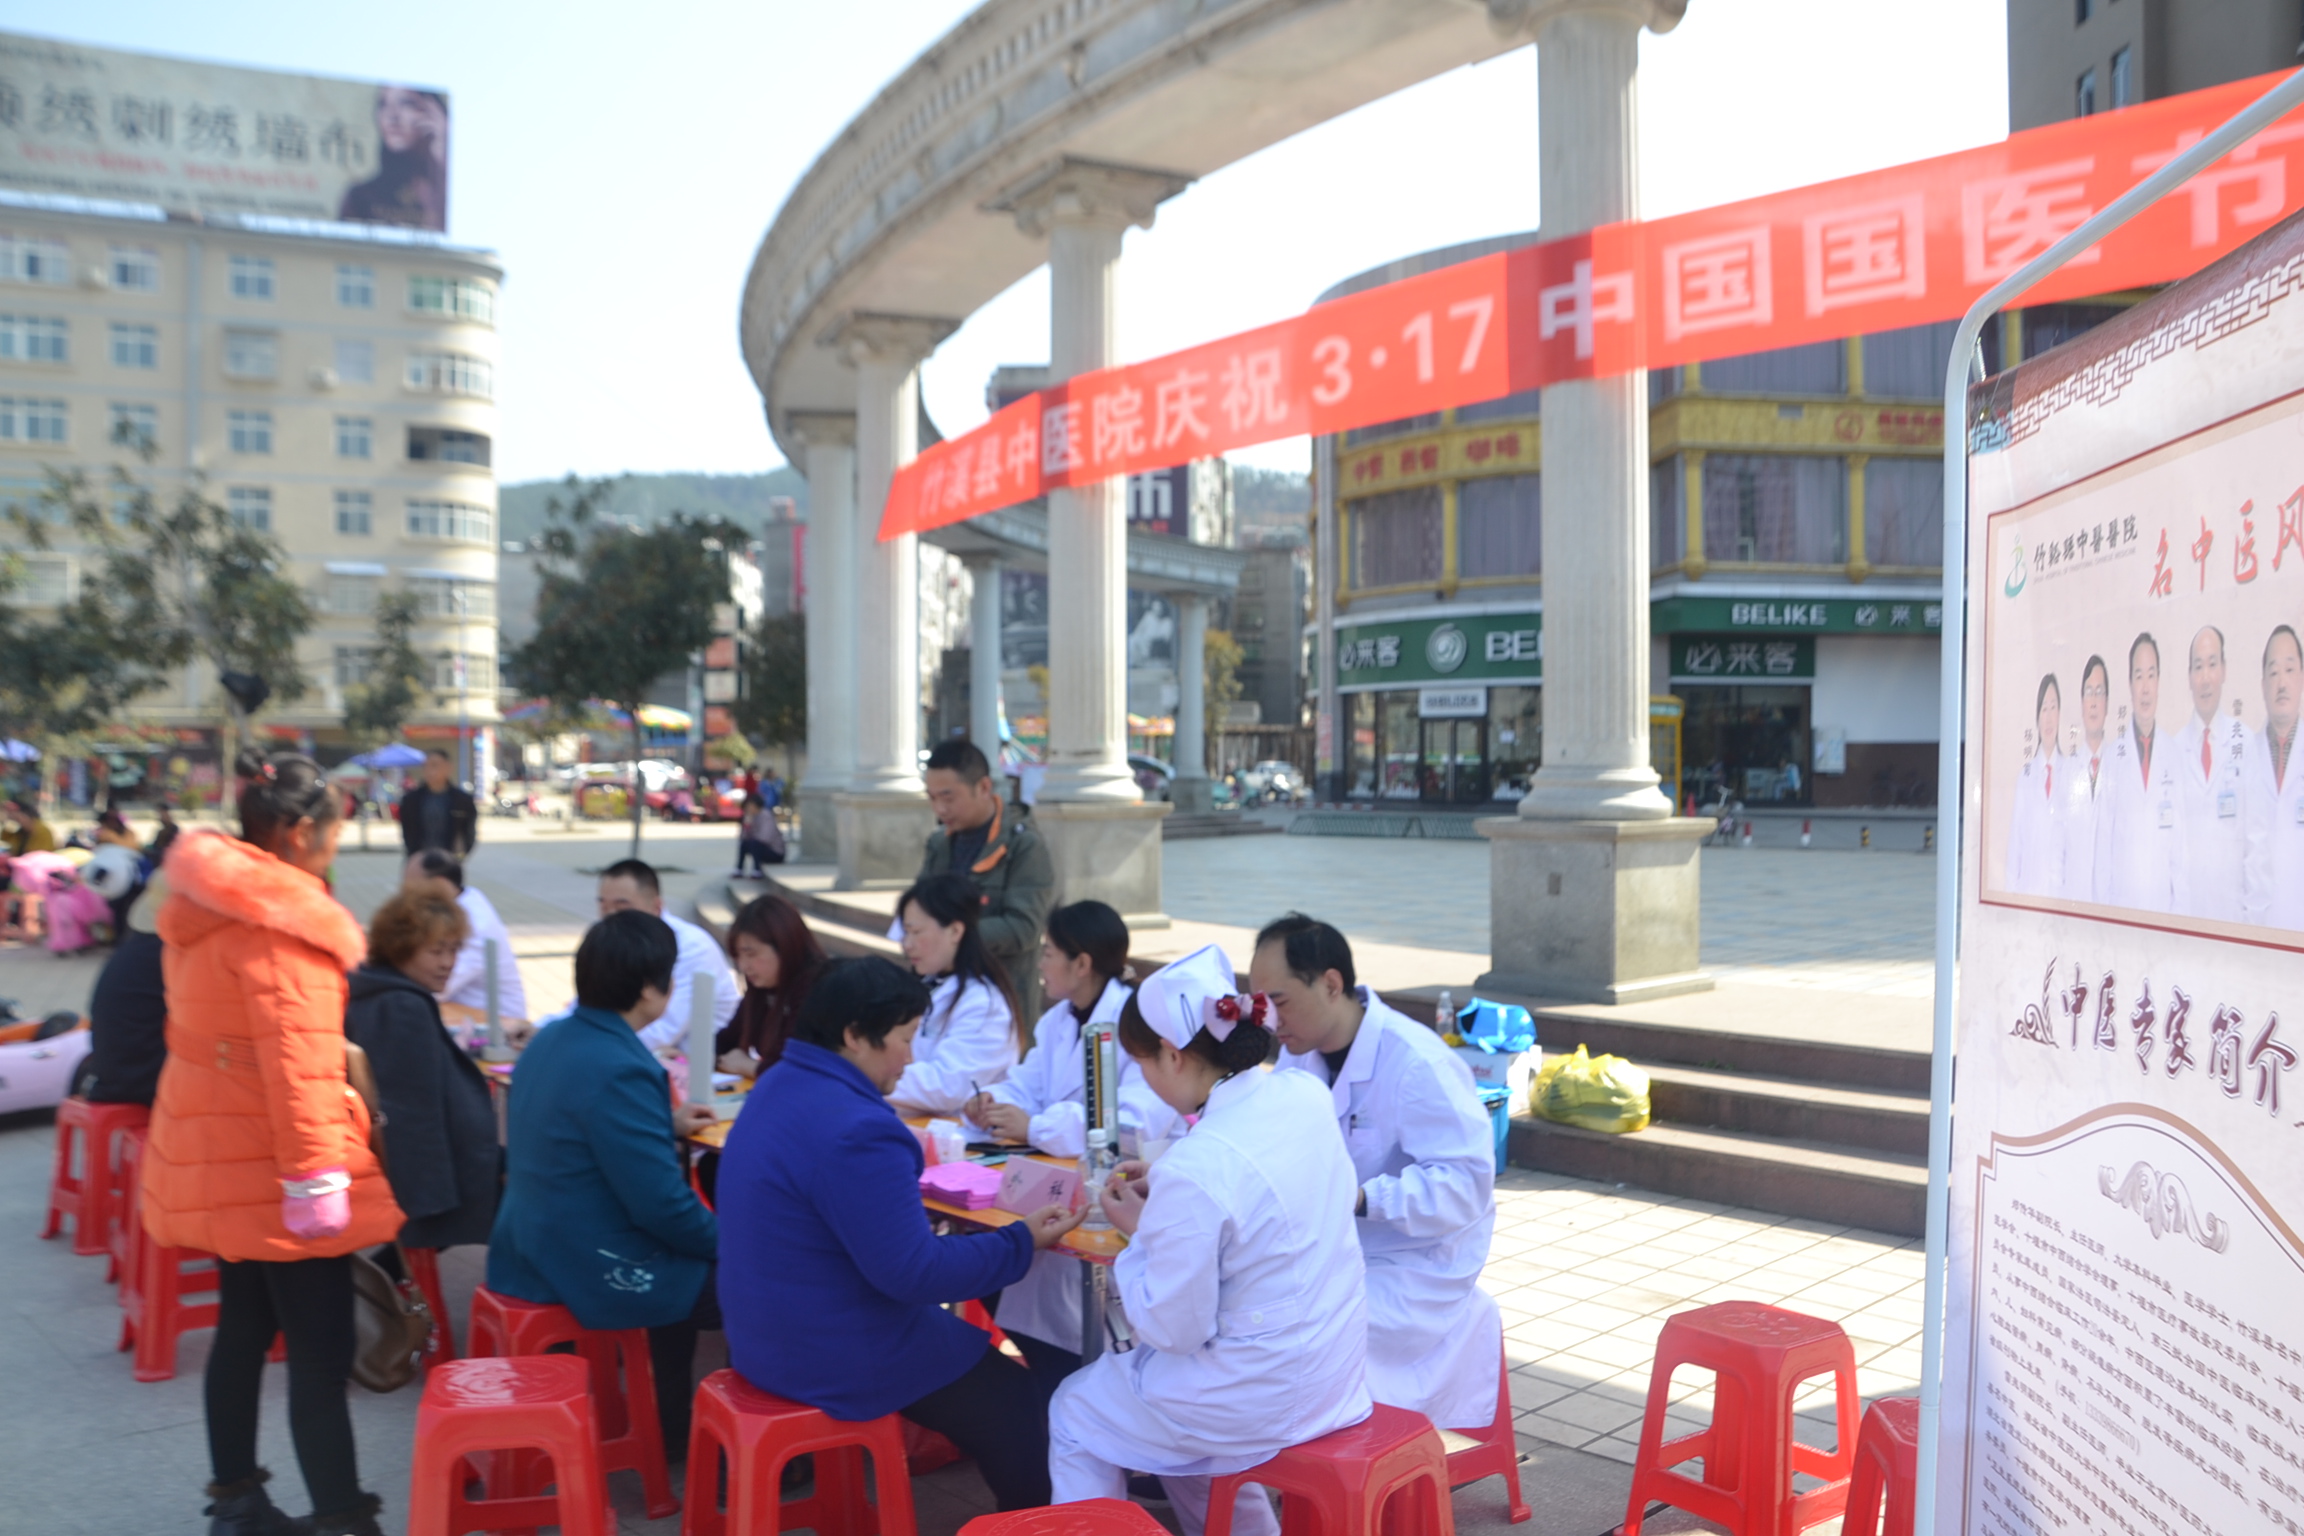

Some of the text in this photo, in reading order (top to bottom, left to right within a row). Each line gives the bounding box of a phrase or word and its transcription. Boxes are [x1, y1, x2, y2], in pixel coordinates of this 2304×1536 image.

[1731, 603, 1828, 626] BELIKE
[1685, 642, 1798, 674] 必来客
